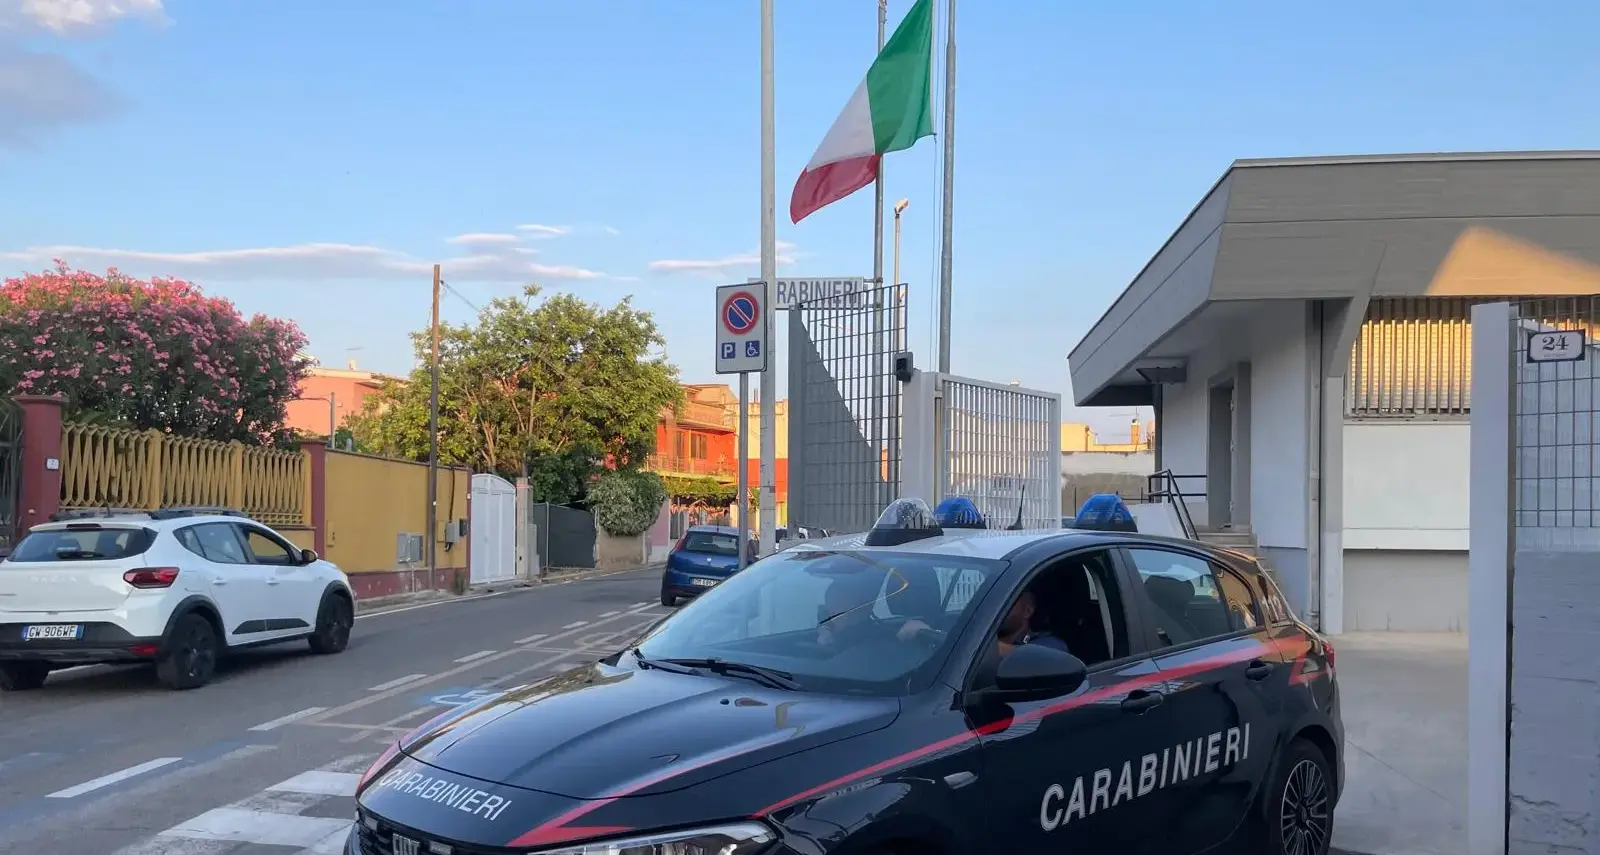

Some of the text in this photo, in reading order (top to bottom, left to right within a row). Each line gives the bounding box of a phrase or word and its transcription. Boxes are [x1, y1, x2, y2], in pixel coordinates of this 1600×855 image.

[777, 281, 858, 304] RABINIERI
[723, 343, 734, 358] P
[1542, 335, 1569, 350] 24
[1040, 722, 1250, 831] CARABINIERI
[379, 769, 512, 820] CARABINIERI
